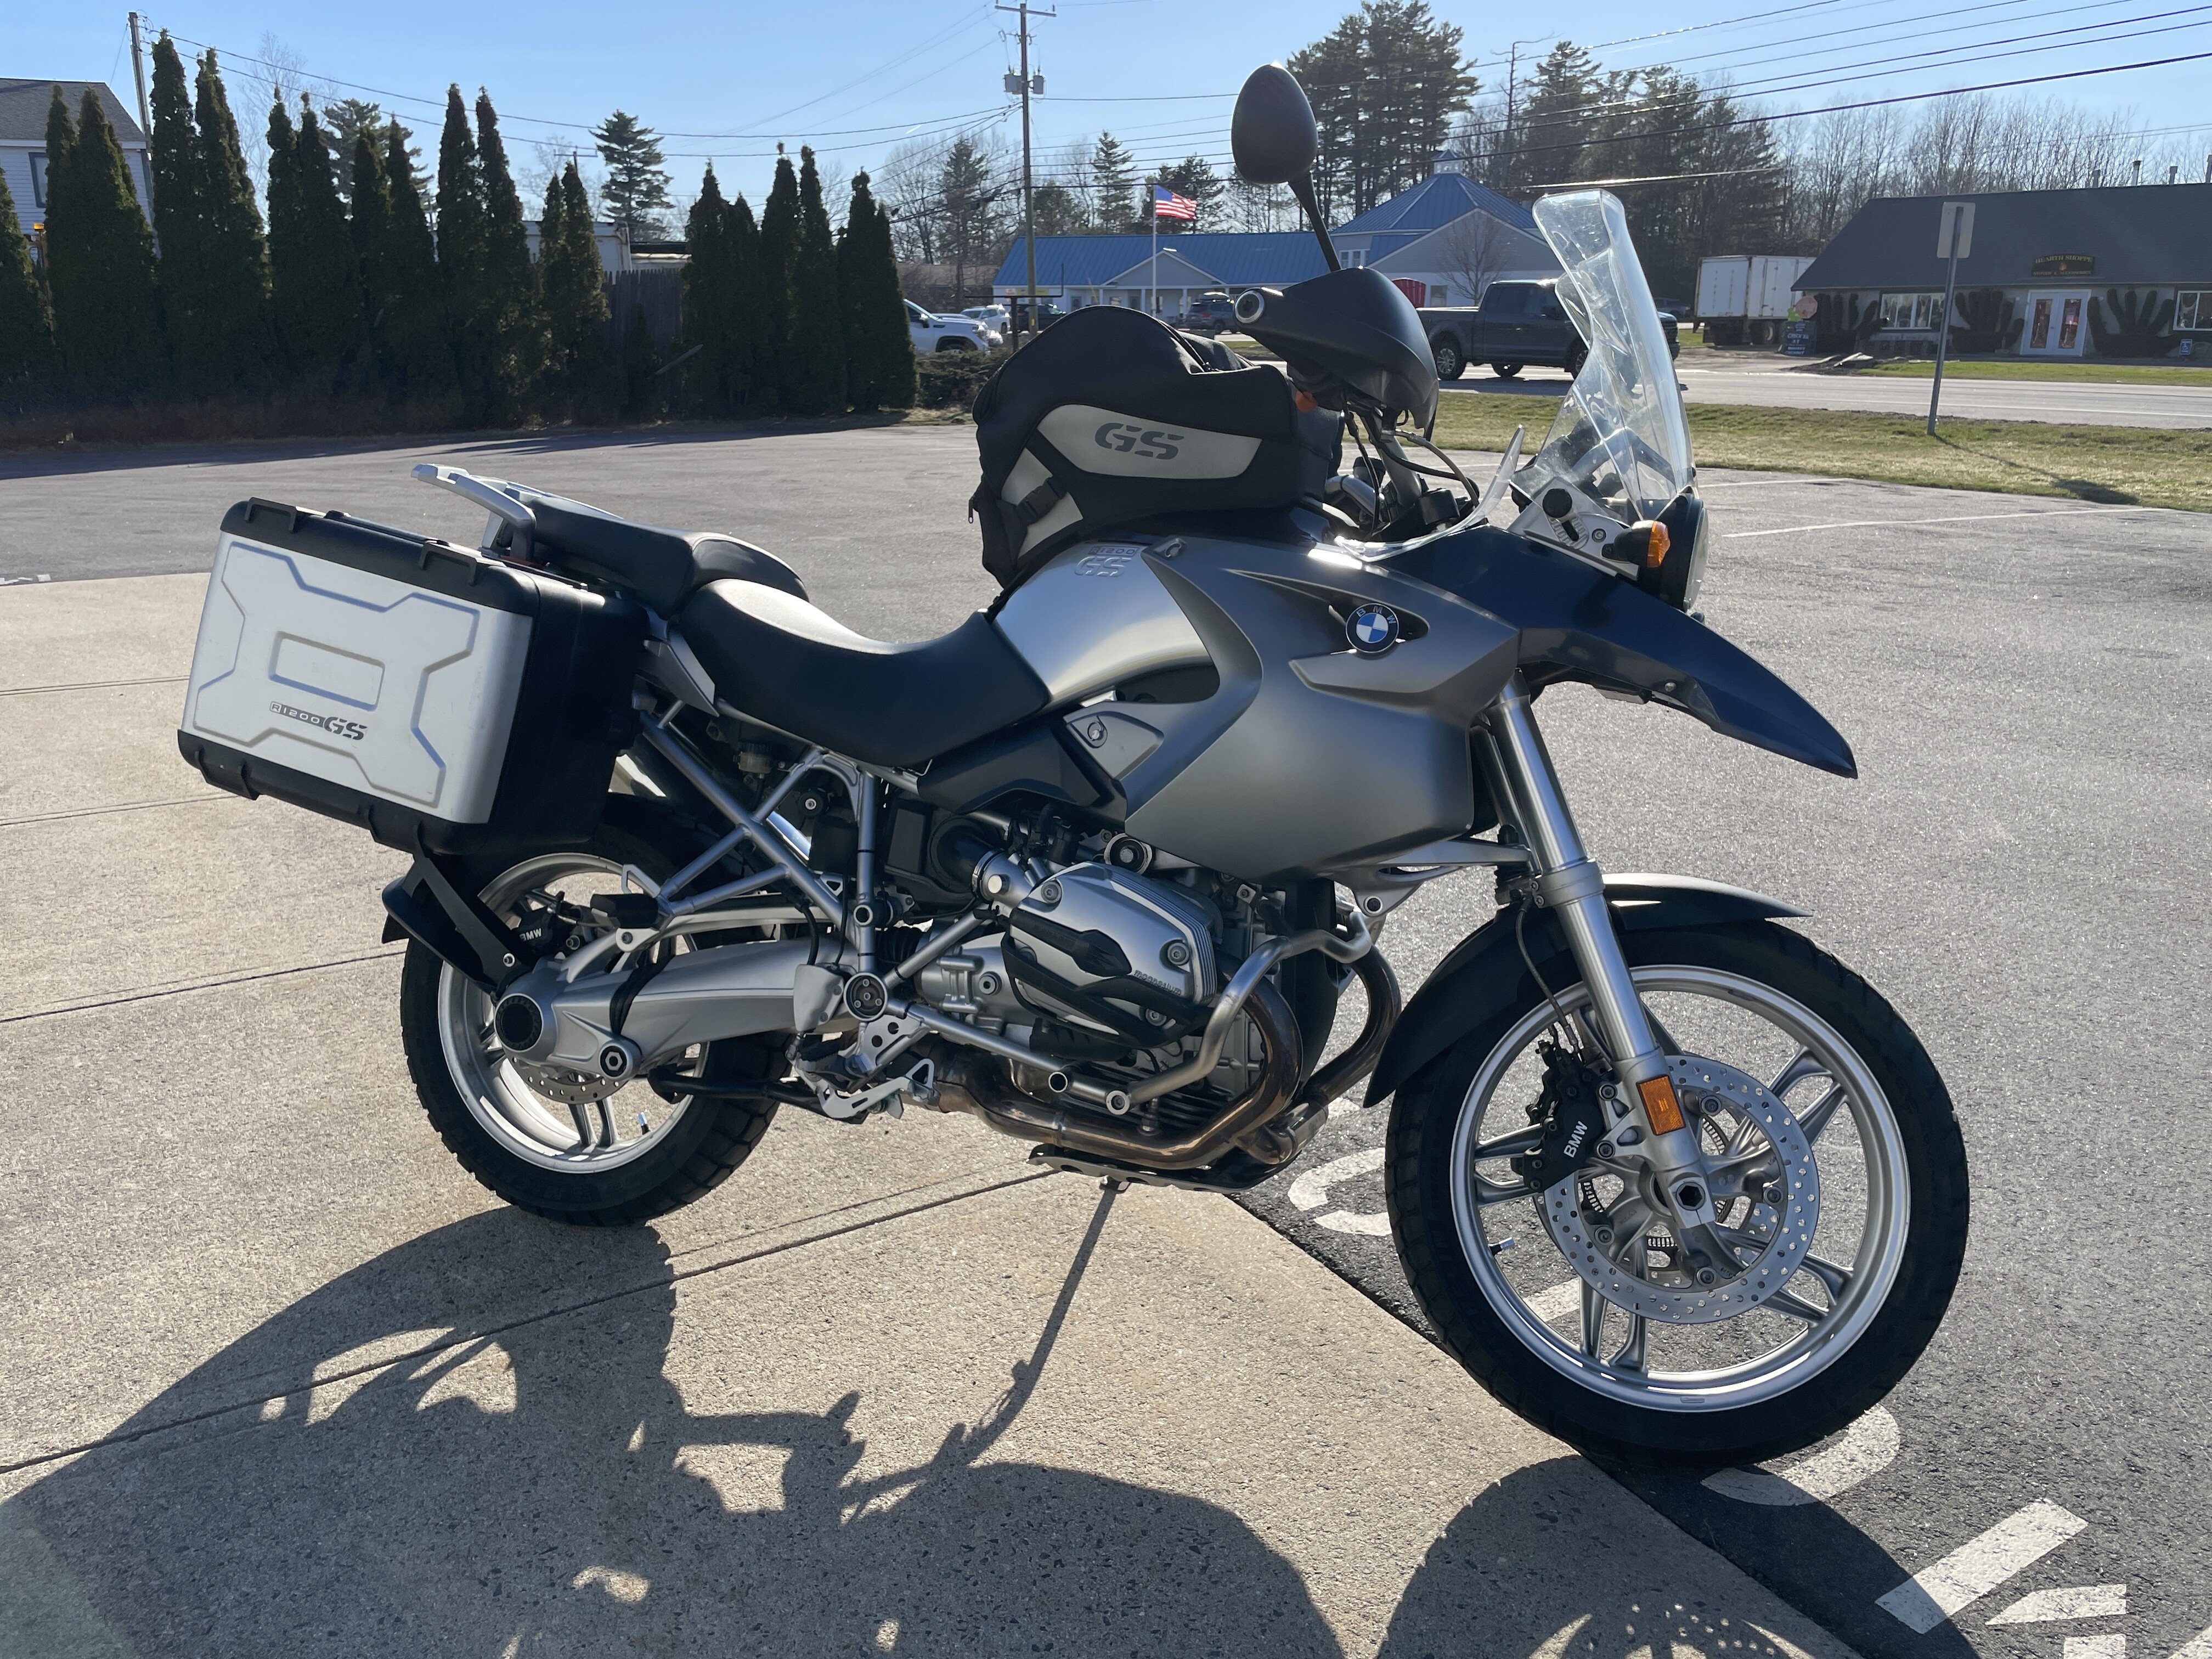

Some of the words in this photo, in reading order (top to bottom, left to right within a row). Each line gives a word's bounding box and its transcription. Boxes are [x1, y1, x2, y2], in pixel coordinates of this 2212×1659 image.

[2035, 255, 2063, 263] HEARTH
[1094, 422, 1185, 460] GS
[1075, 556, 1132, 577] GS
[1356, 605, 1397, 624] BMW
[519, 928, 542, 941] BMW
[1133, 969, 1183, 996] magnesium
[1564, 1120, 1588, 1158] BMW
